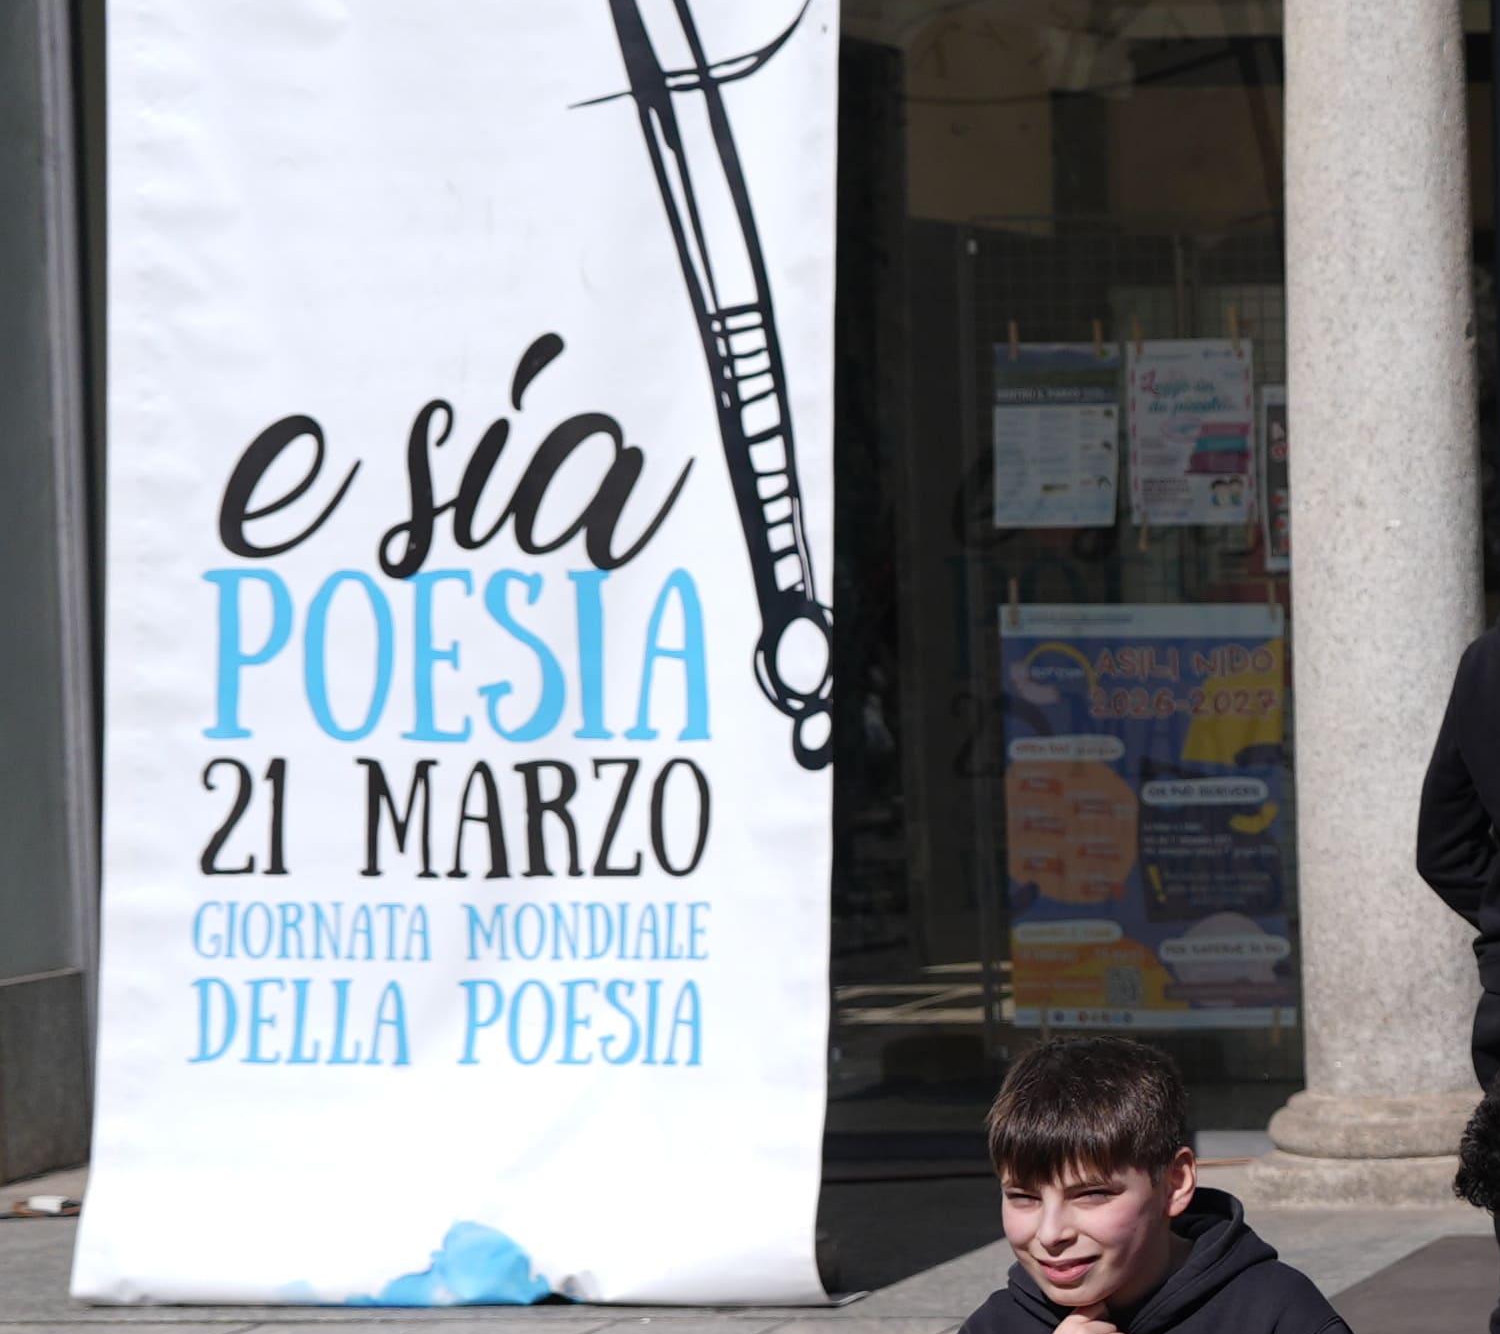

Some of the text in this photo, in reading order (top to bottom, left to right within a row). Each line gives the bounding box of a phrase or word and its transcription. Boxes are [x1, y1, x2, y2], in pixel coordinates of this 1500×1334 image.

[220, 415, 360, 558] e
[202, 566, 711, 743] POESIA
[1094, 645, 1275, 682] ASILI NIDO
[1090, 687, 1280, 719] 2026-2027
[201, 759, 710, 878] 21 MARZO
[193, 902, 709, 961] GIORNATA MONDIALE
[191, 978, 701, 1066] DELLA POESIA
